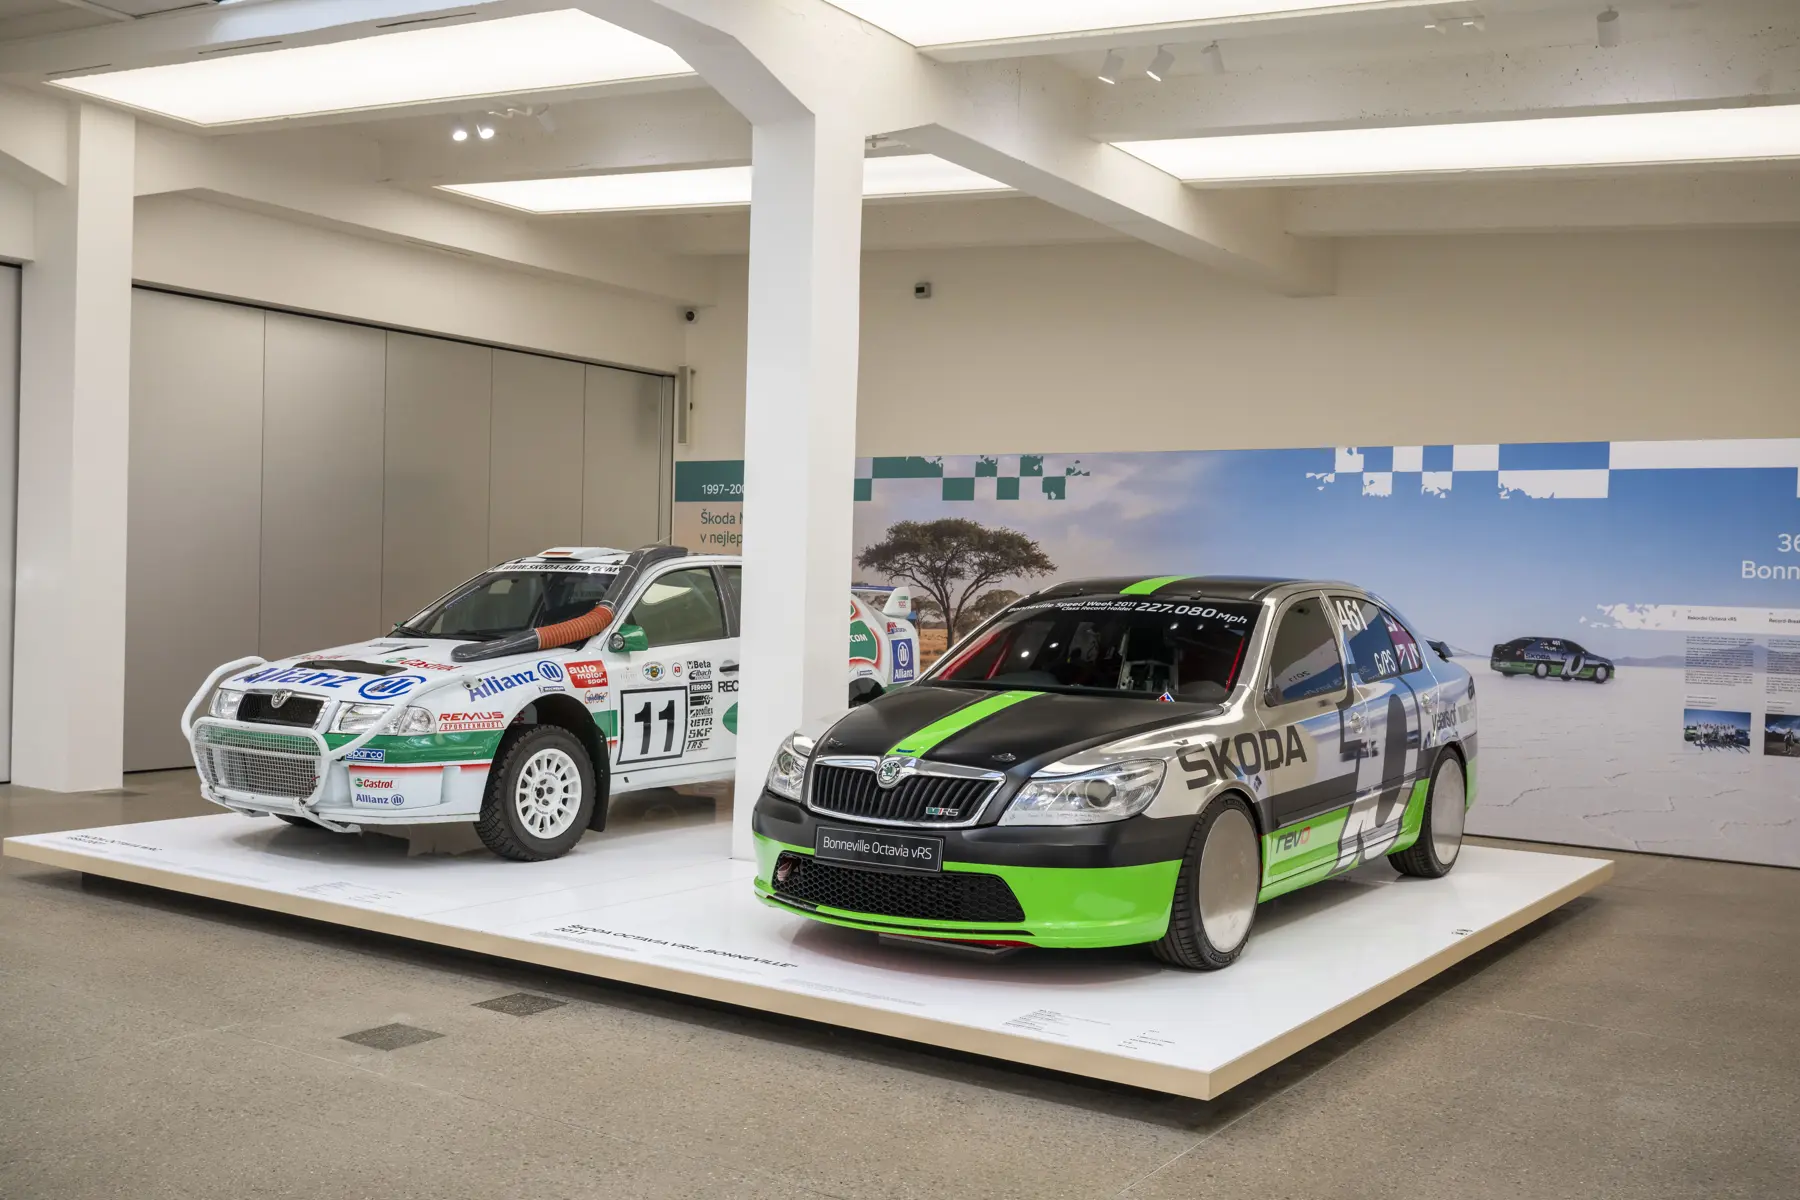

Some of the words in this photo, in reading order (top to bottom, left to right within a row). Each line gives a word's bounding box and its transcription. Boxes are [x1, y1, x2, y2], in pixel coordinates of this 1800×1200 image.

[701, 509, 736, 524] Škoda
[700, 533, 707, 543] v
[709, 531, 743, 547] nejlep
[1742, 560, 1800, 579] Bonn
[1007, 602, 1054, 612] Bonneville
[1135, 602, 1217, 618] 227.080
[1216, 612, 1248, 624] Mph
[1336, 600, 1368, 631] 461
[568, 664, 597, 674] auto
[693, 660, 711, 669] Beta
[1374, 649, 1396, 676] G/PS
[577, 672, 604, 680] motor
[894, 669, 913, 680] Allianz
[469, 670, 540, 702] Allianz
[439, 711, 505, 721] REMUS
[634, 700, 675, 755] 11
[688, 727, 712, 738] SKF
[346, 750, 383, 759] sparco
[1174, 725, 1308, 790] ŠKODA
[363, 779, 393, 788] Castrol
[356, 793, 389, 804] Allianz
[1275, 826, 1311, 853] revo
[823, 836, 870, 853] Bonneville
[872, 841, 909, 858] Octavia
[911, 847, 932, 860] vRS
[553, 926, 588, 936] 2011
